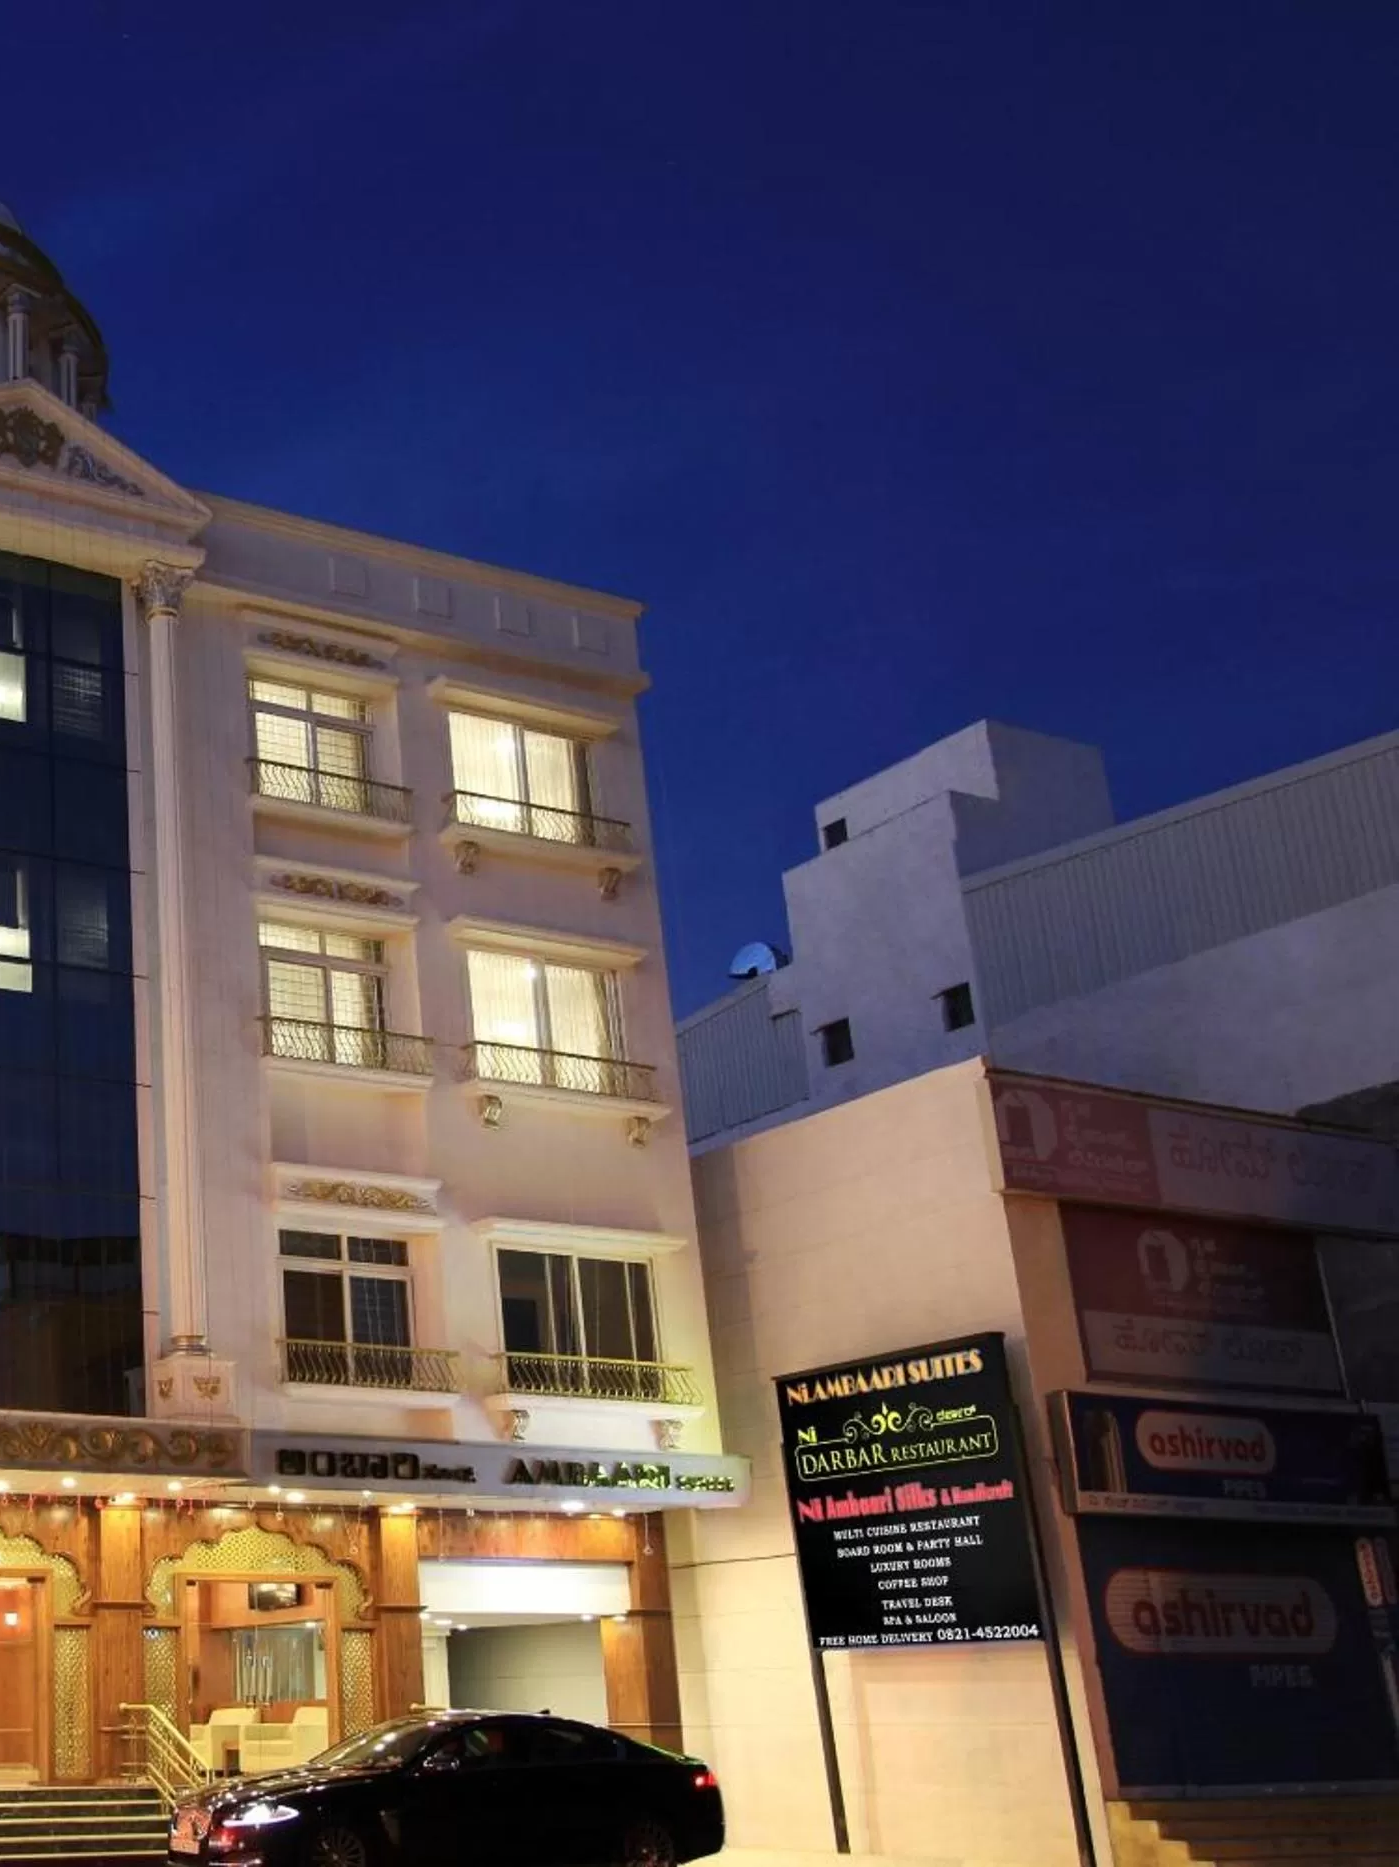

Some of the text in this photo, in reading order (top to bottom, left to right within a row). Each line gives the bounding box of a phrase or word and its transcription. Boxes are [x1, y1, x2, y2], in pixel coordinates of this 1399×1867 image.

[908, 1348, 984, 1383] SUITES
[801, 1432, 992, 1476] DARBAR RESTAURANT
[1149, 1425, 1267, 1462] ashirvad
[833, 1516, 980, 1541] MULTI CUISINE RESTAURANT
[837, 1546, 870, 1559] BOARD
[873, 1542, 903, 1555] ROOM
[917, 1537, 950, 1551] PARTY
[954, 1534, 983, 1548] HALL
[870, 1557, 952, 1573] LUXURY ROOMS
[878, 1575, 949, 1590] COFFEE SHOP
[882, 1596, 952, 1611] TRAVEL DESK
[1132, 1589, 1313, 1637] ashirvad
[883, 1615, 902, 1627] SPA
[915, 1612, 957, 1624] SALOON
[819, 1624, 1039, 1647] FREE HOME DELIVERY 0821-4522004
